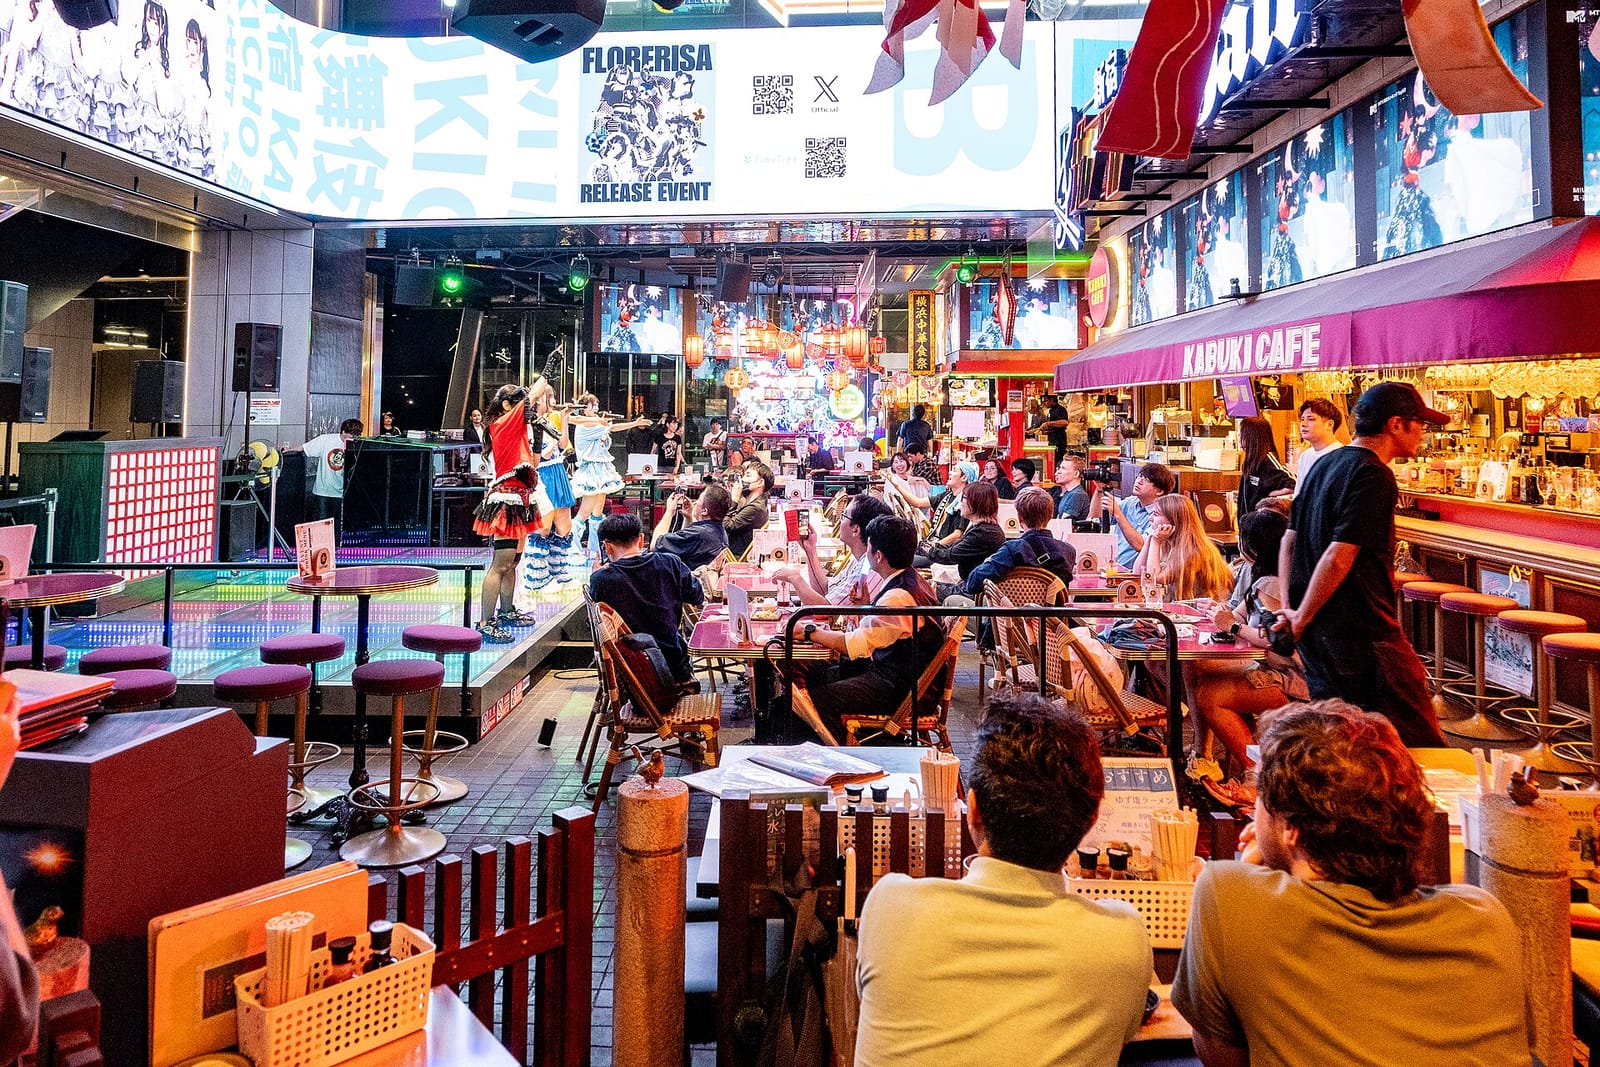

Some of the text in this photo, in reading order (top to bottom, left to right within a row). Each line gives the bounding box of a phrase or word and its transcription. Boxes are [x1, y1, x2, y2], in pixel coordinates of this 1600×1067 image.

[1566, 10, 1586, 23] MTV
[582, 44, 713, 74] FLORERISA
[306, 30, 389, 217] 舞伎
[261, 108, 300, 203] KA
[580, 181, 712, 203] RELEASE EVENT
[915, 296, 929, 370] 横浜中華食祭
[1182, 323, 1321, 378] KABUKI CAFE
